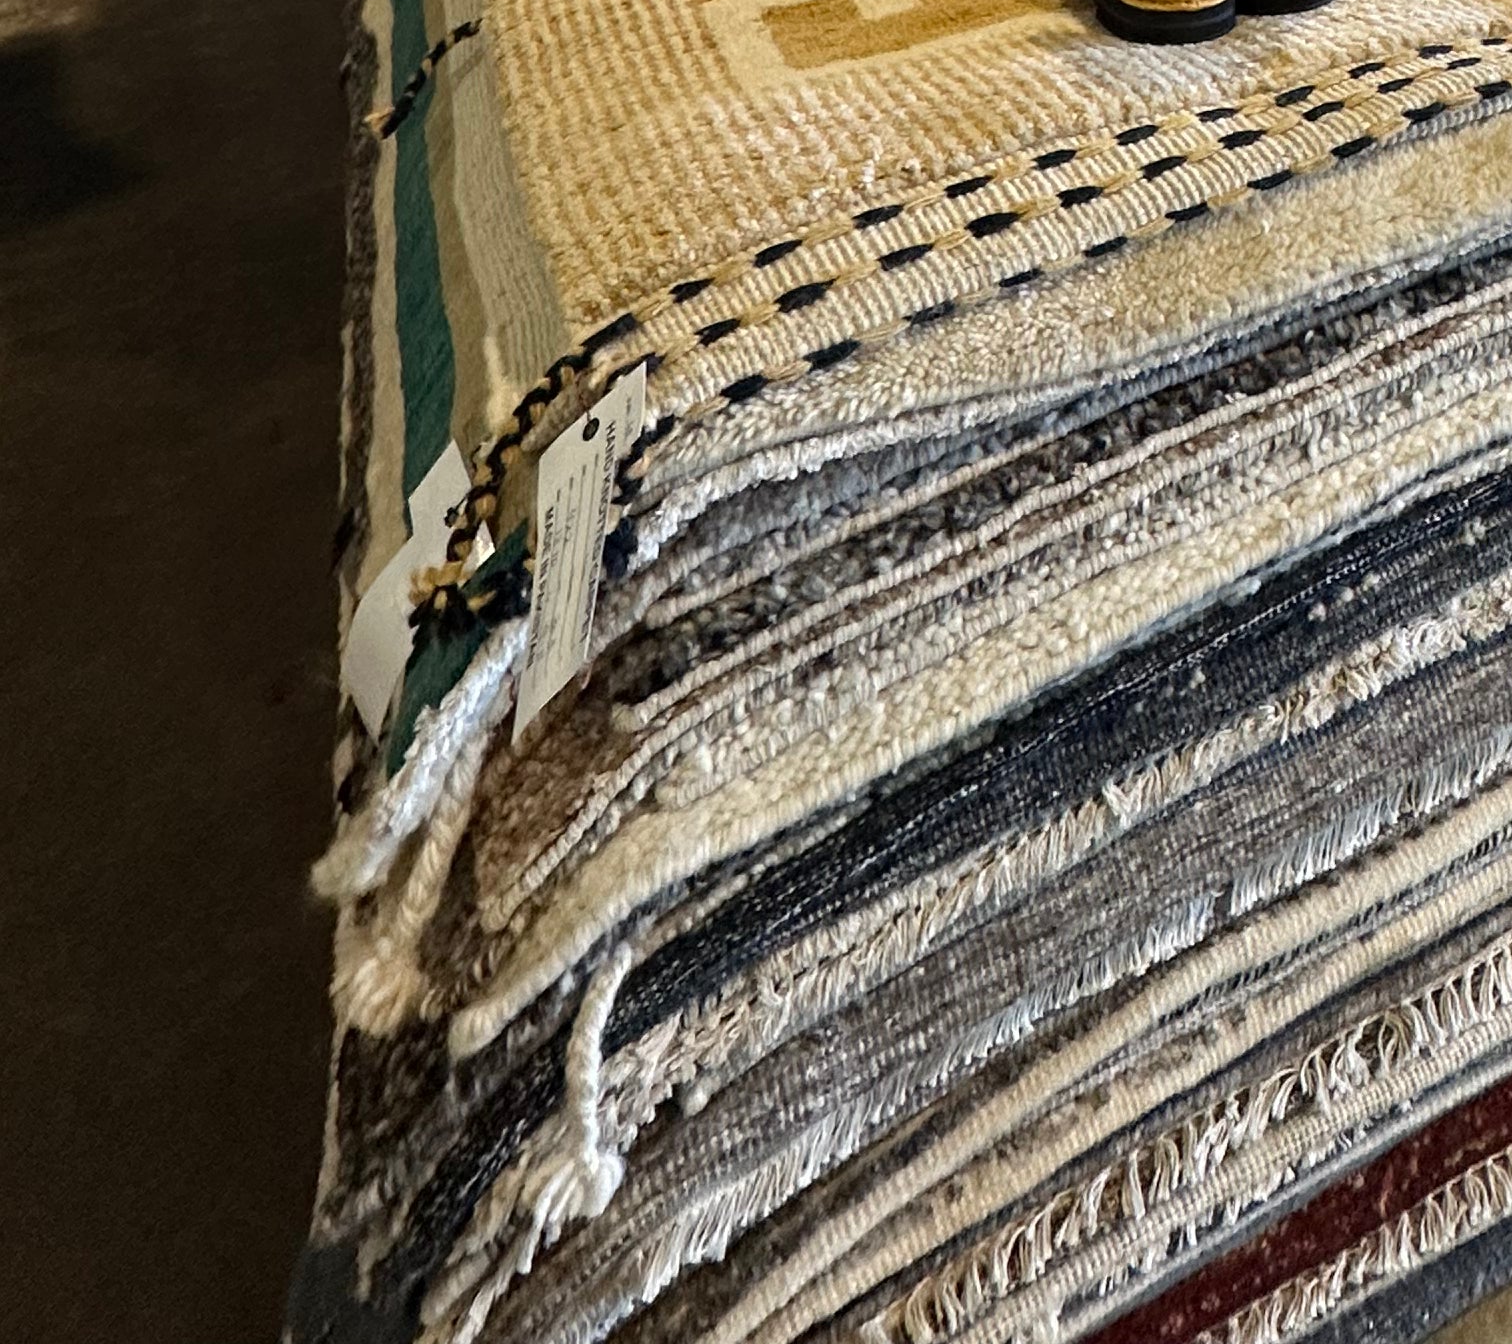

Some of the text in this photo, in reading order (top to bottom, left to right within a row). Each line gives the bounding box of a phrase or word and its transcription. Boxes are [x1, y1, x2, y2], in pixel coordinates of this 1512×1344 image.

[603, 419, 616, 472] HAND
[543, 506, 554, 554] MADE
[592, 473, 611, 561] KNOTTED
[539, 556, 550, 577] IN
